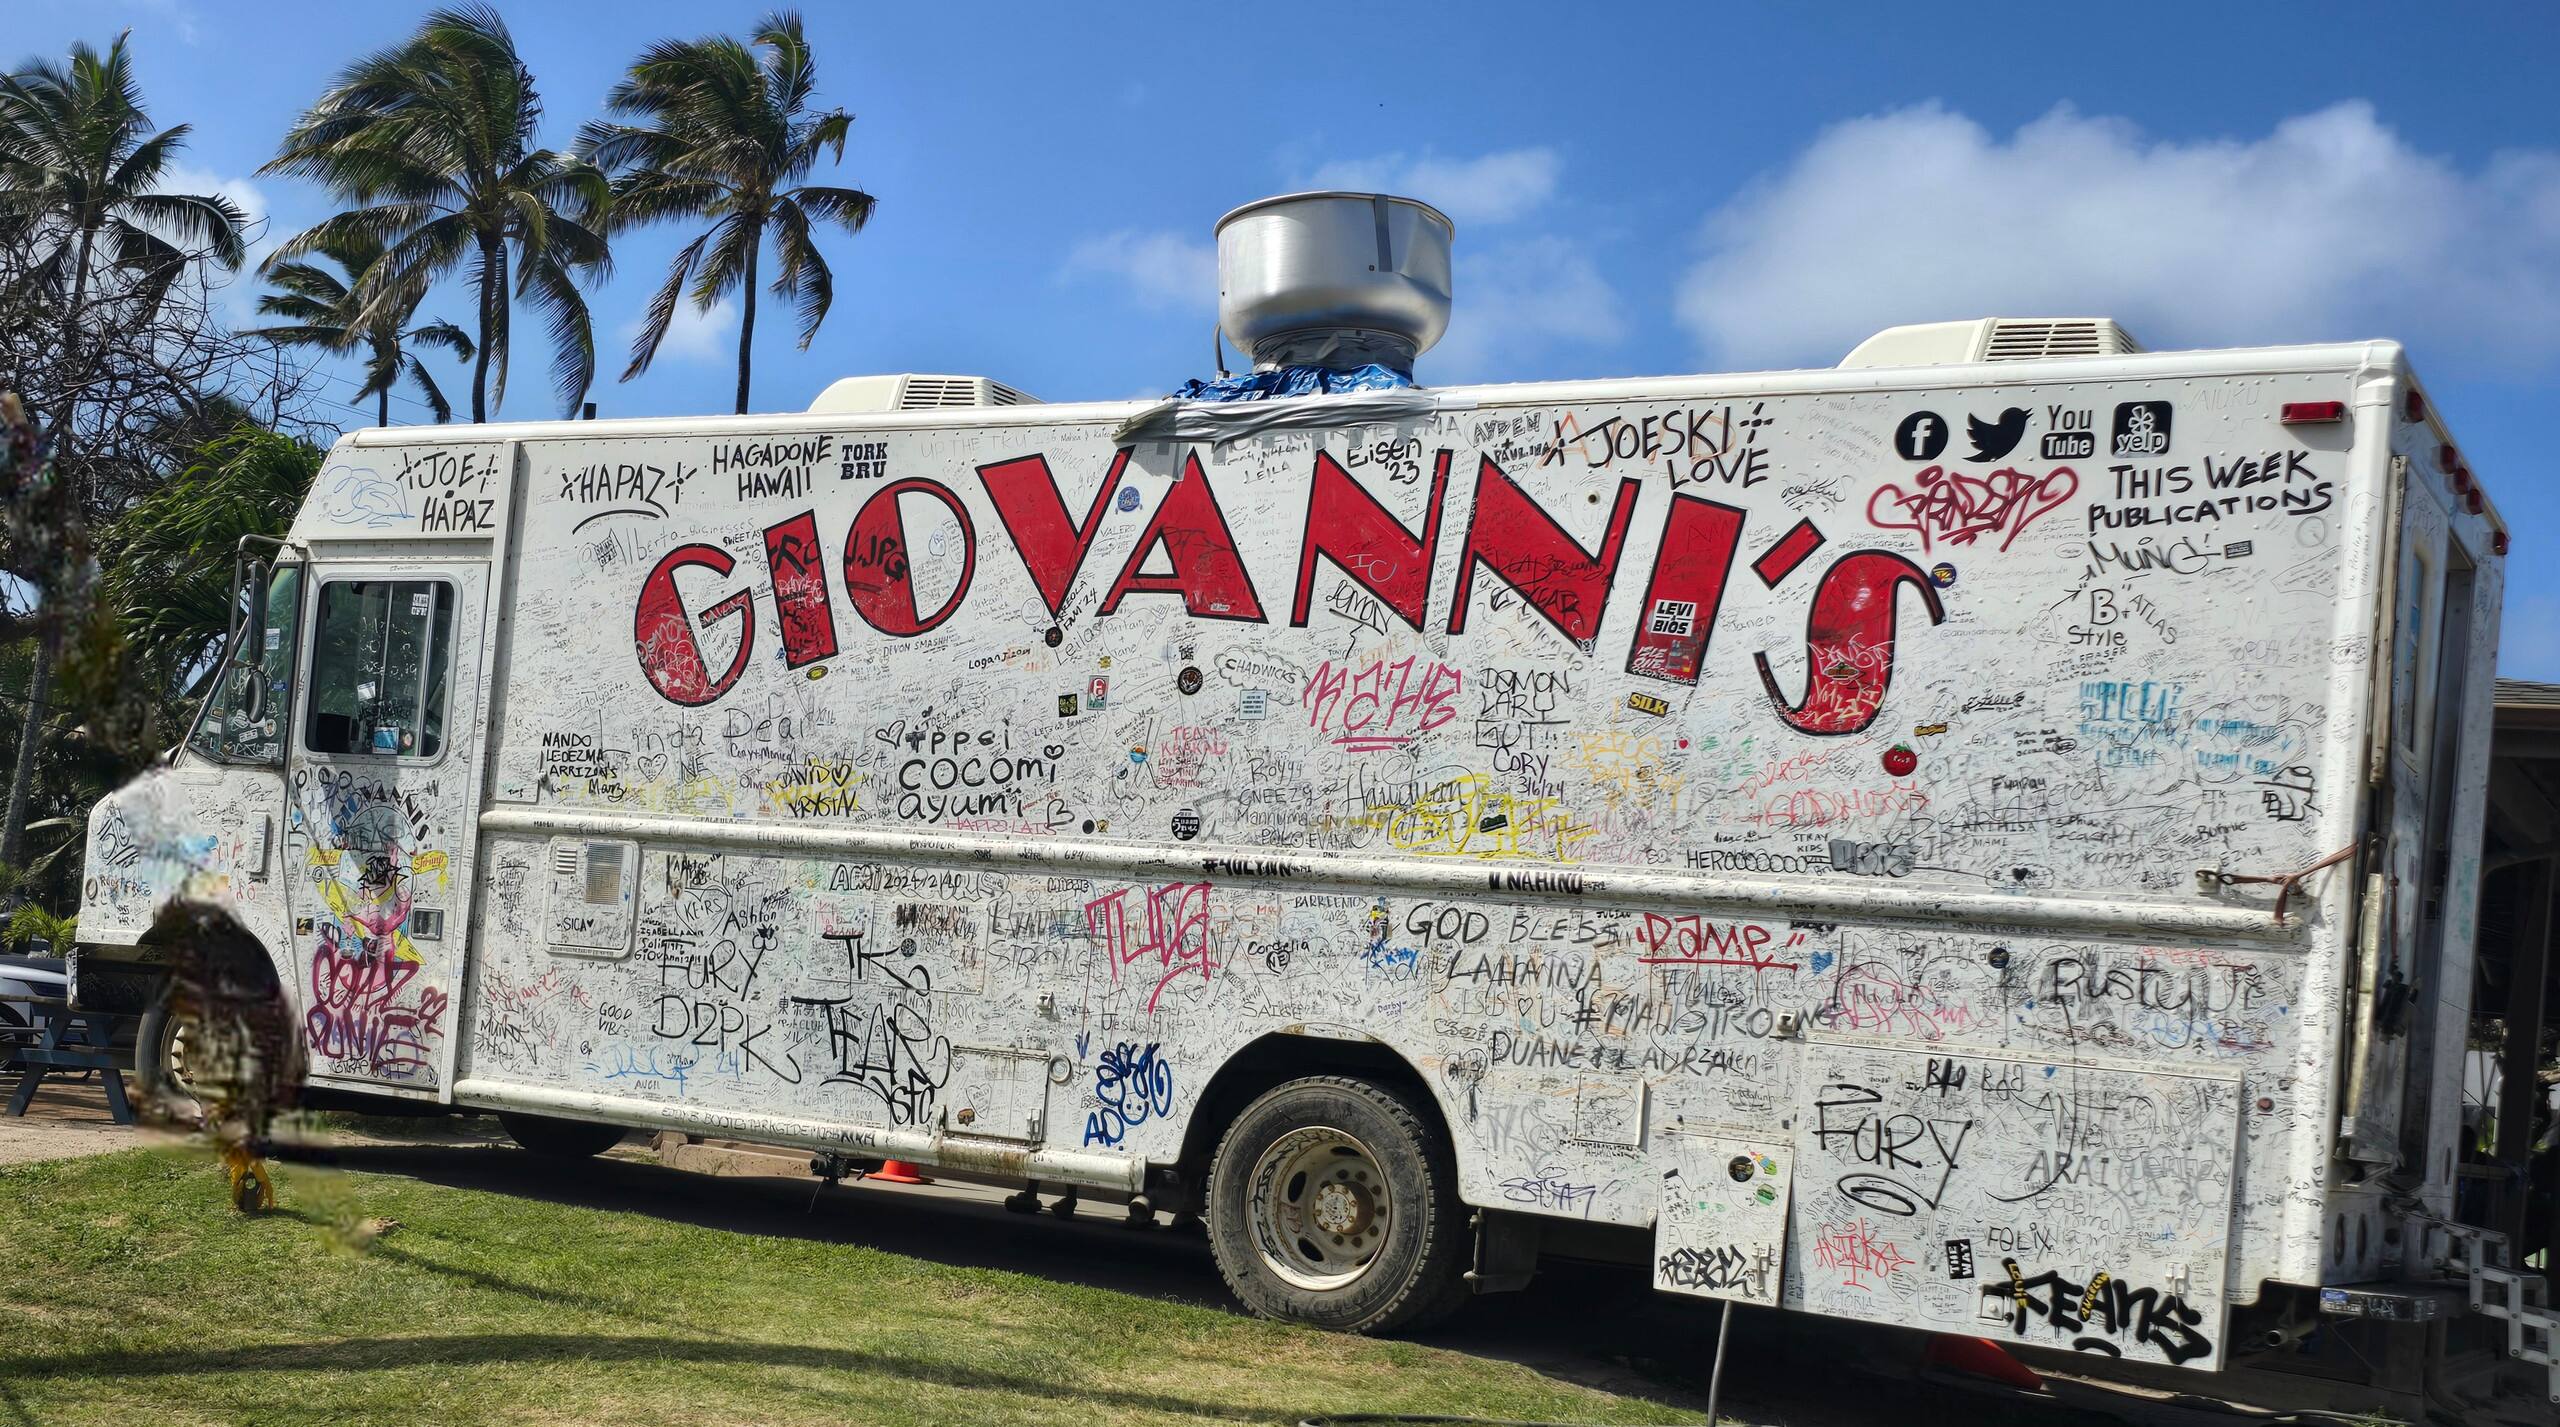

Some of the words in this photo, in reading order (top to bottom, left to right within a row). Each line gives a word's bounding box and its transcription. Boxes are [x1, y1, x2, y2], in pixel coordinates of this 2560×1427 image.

[2047, 404, 2093, 430] You
[842, 442, 888, 462] TORK
[1569, 406, 1730, 468] JOESKI
[2045, 436, 2092, 457] Tube
[2116, 430, 2165, 454] yelp
[417, 451, 475, 488] JOE
[713, 435, 833, 475] HAGADONE
[840, 461, 887, 480] BRU
[1666, 448, 1769, 490] LOVE
[580, 464, 668, 518] HAPAZ
[737, 465, 811, 501] HAWAII
[2108, 464, 2194, 499] THIS
[2203, 450, 2318, 490] WEEK
[421, 498, 495, 533] HAPAZ
[2088, 482, 2333, 532] PUBLICATIONS
[634, 443, 1947, 737] GIOVANNI'S
[1656, 601, 1693, 617] LEVI
[2067, 624, 2128, 647] Style
[1628, 692, 1669, 717] SILK
[543, 733, 592, 748] NANDO
[546, 749, 604, 763] LEDEZMA
[1493, 747, 1549, 784] CORY
[1517, 777, 1566, 803] 3/6/24
[1792, 833, 1829, 842] STRAY
[1406, 902, 1490, 948] GOD
[658, 939, 766, 1003] FURY
[600, 1001, 632, 1020] GOOD
[1960, 1243, 1972, 1277] WAY
